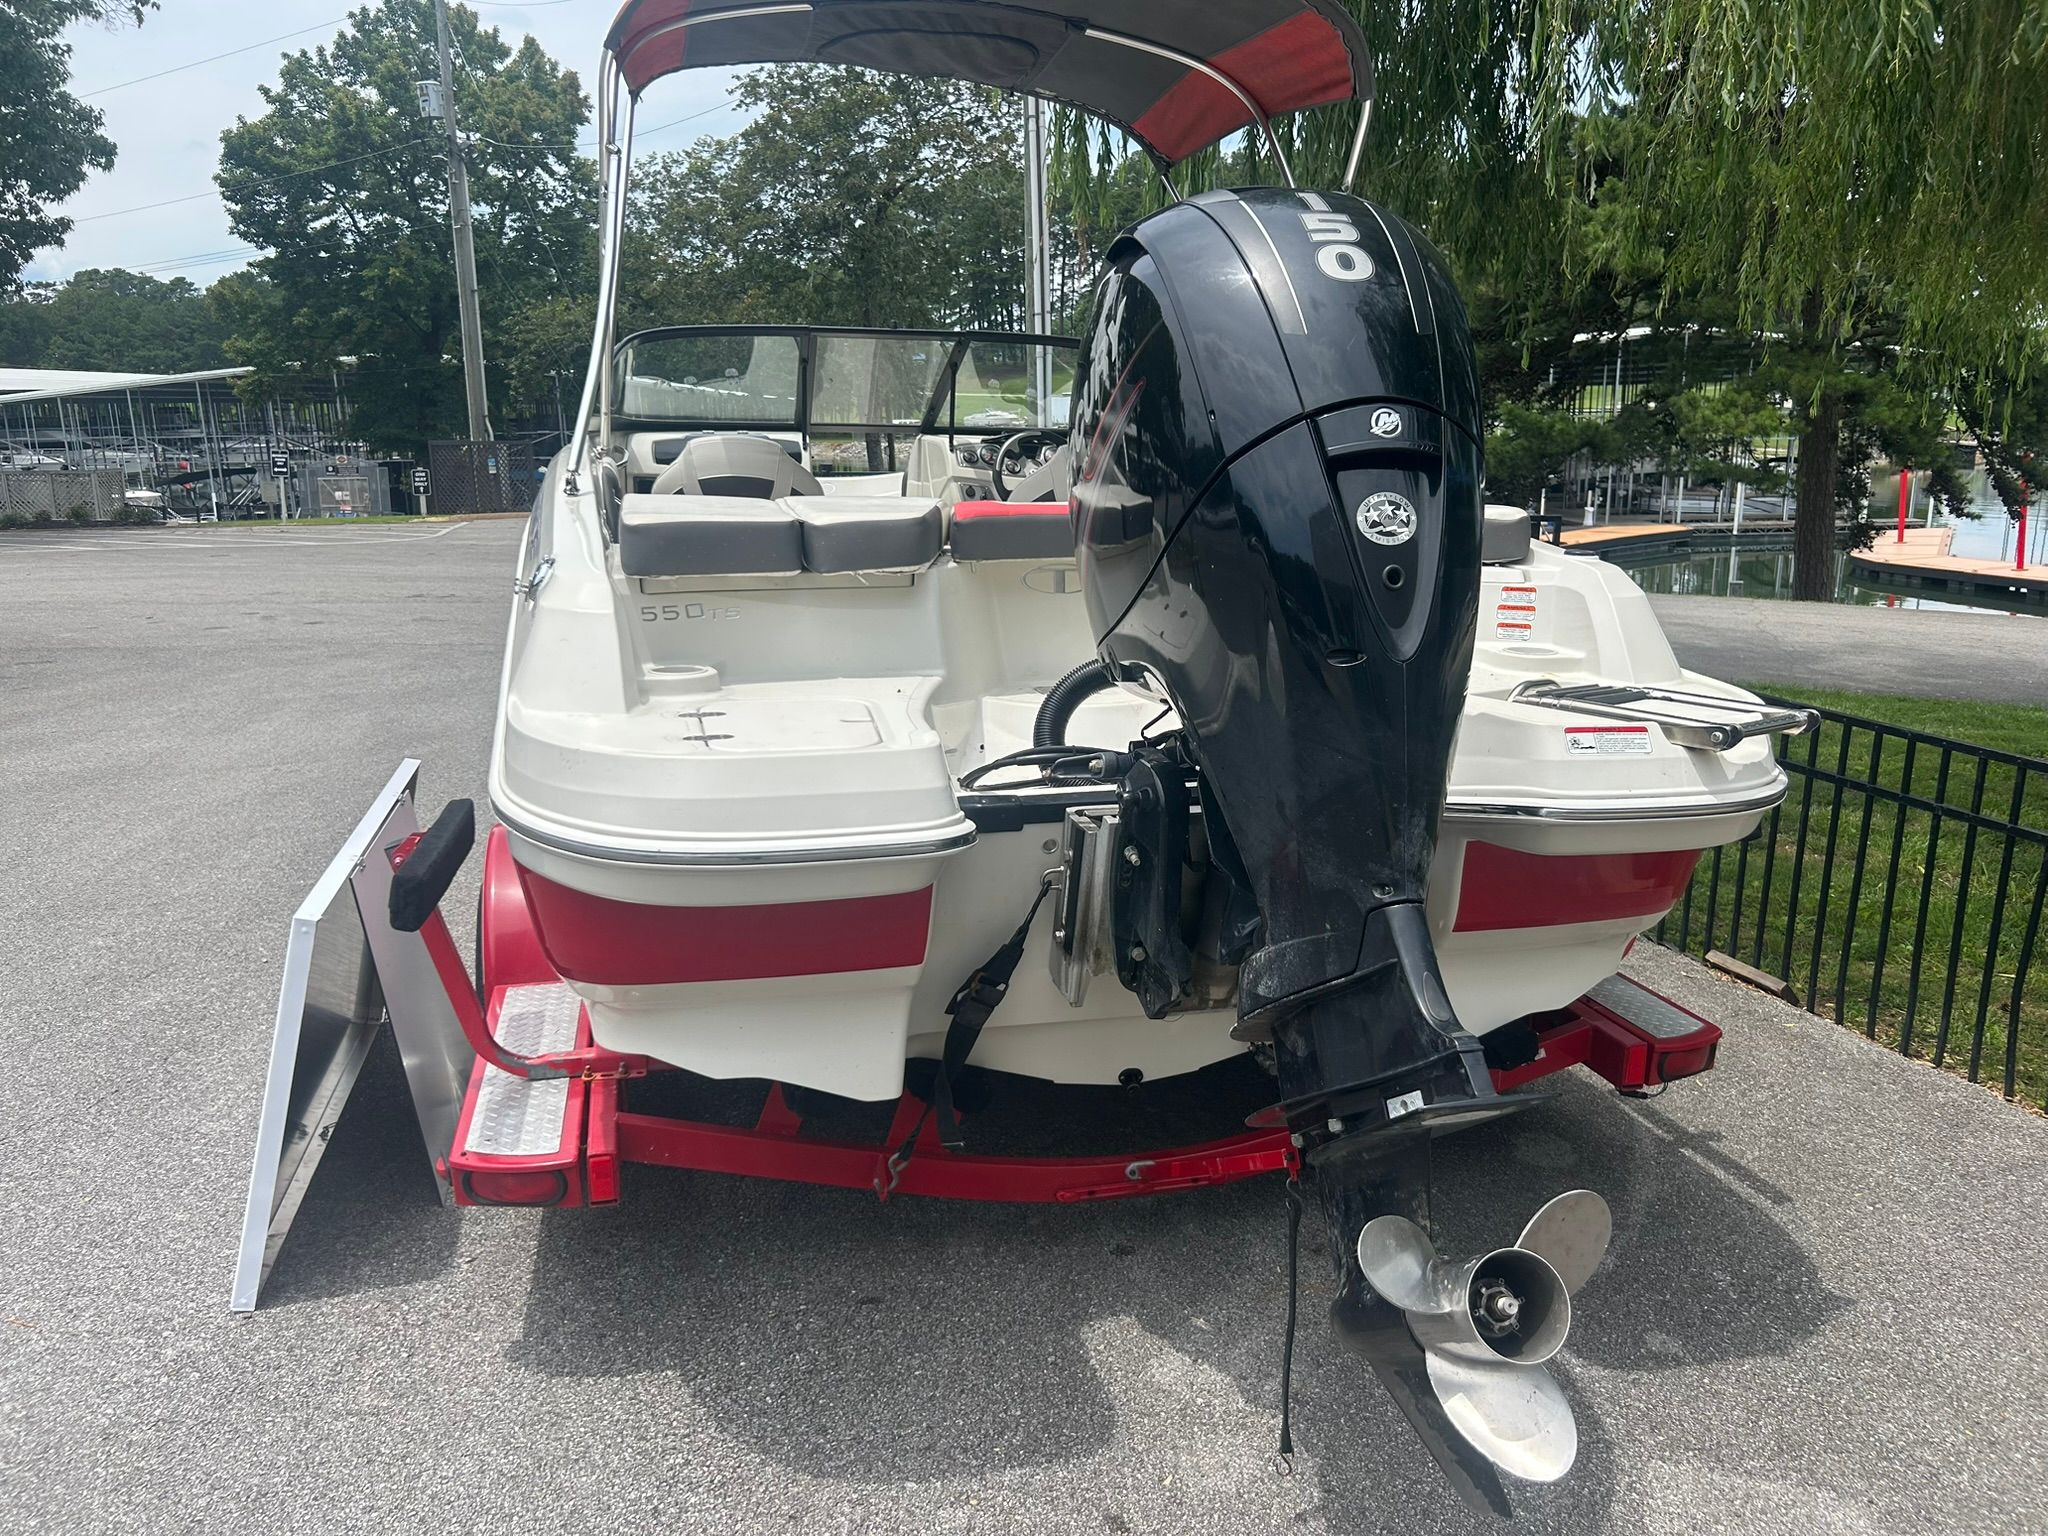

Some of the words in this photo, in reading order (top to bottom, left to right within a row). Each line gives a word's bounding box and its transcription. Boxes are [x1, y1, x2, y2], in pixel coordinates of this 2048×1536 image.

[1295, 192, 1376, 282] 150
[1363, 493, 1388, 508] ULTRA
[1394, 495, 1411, 508] LOW
